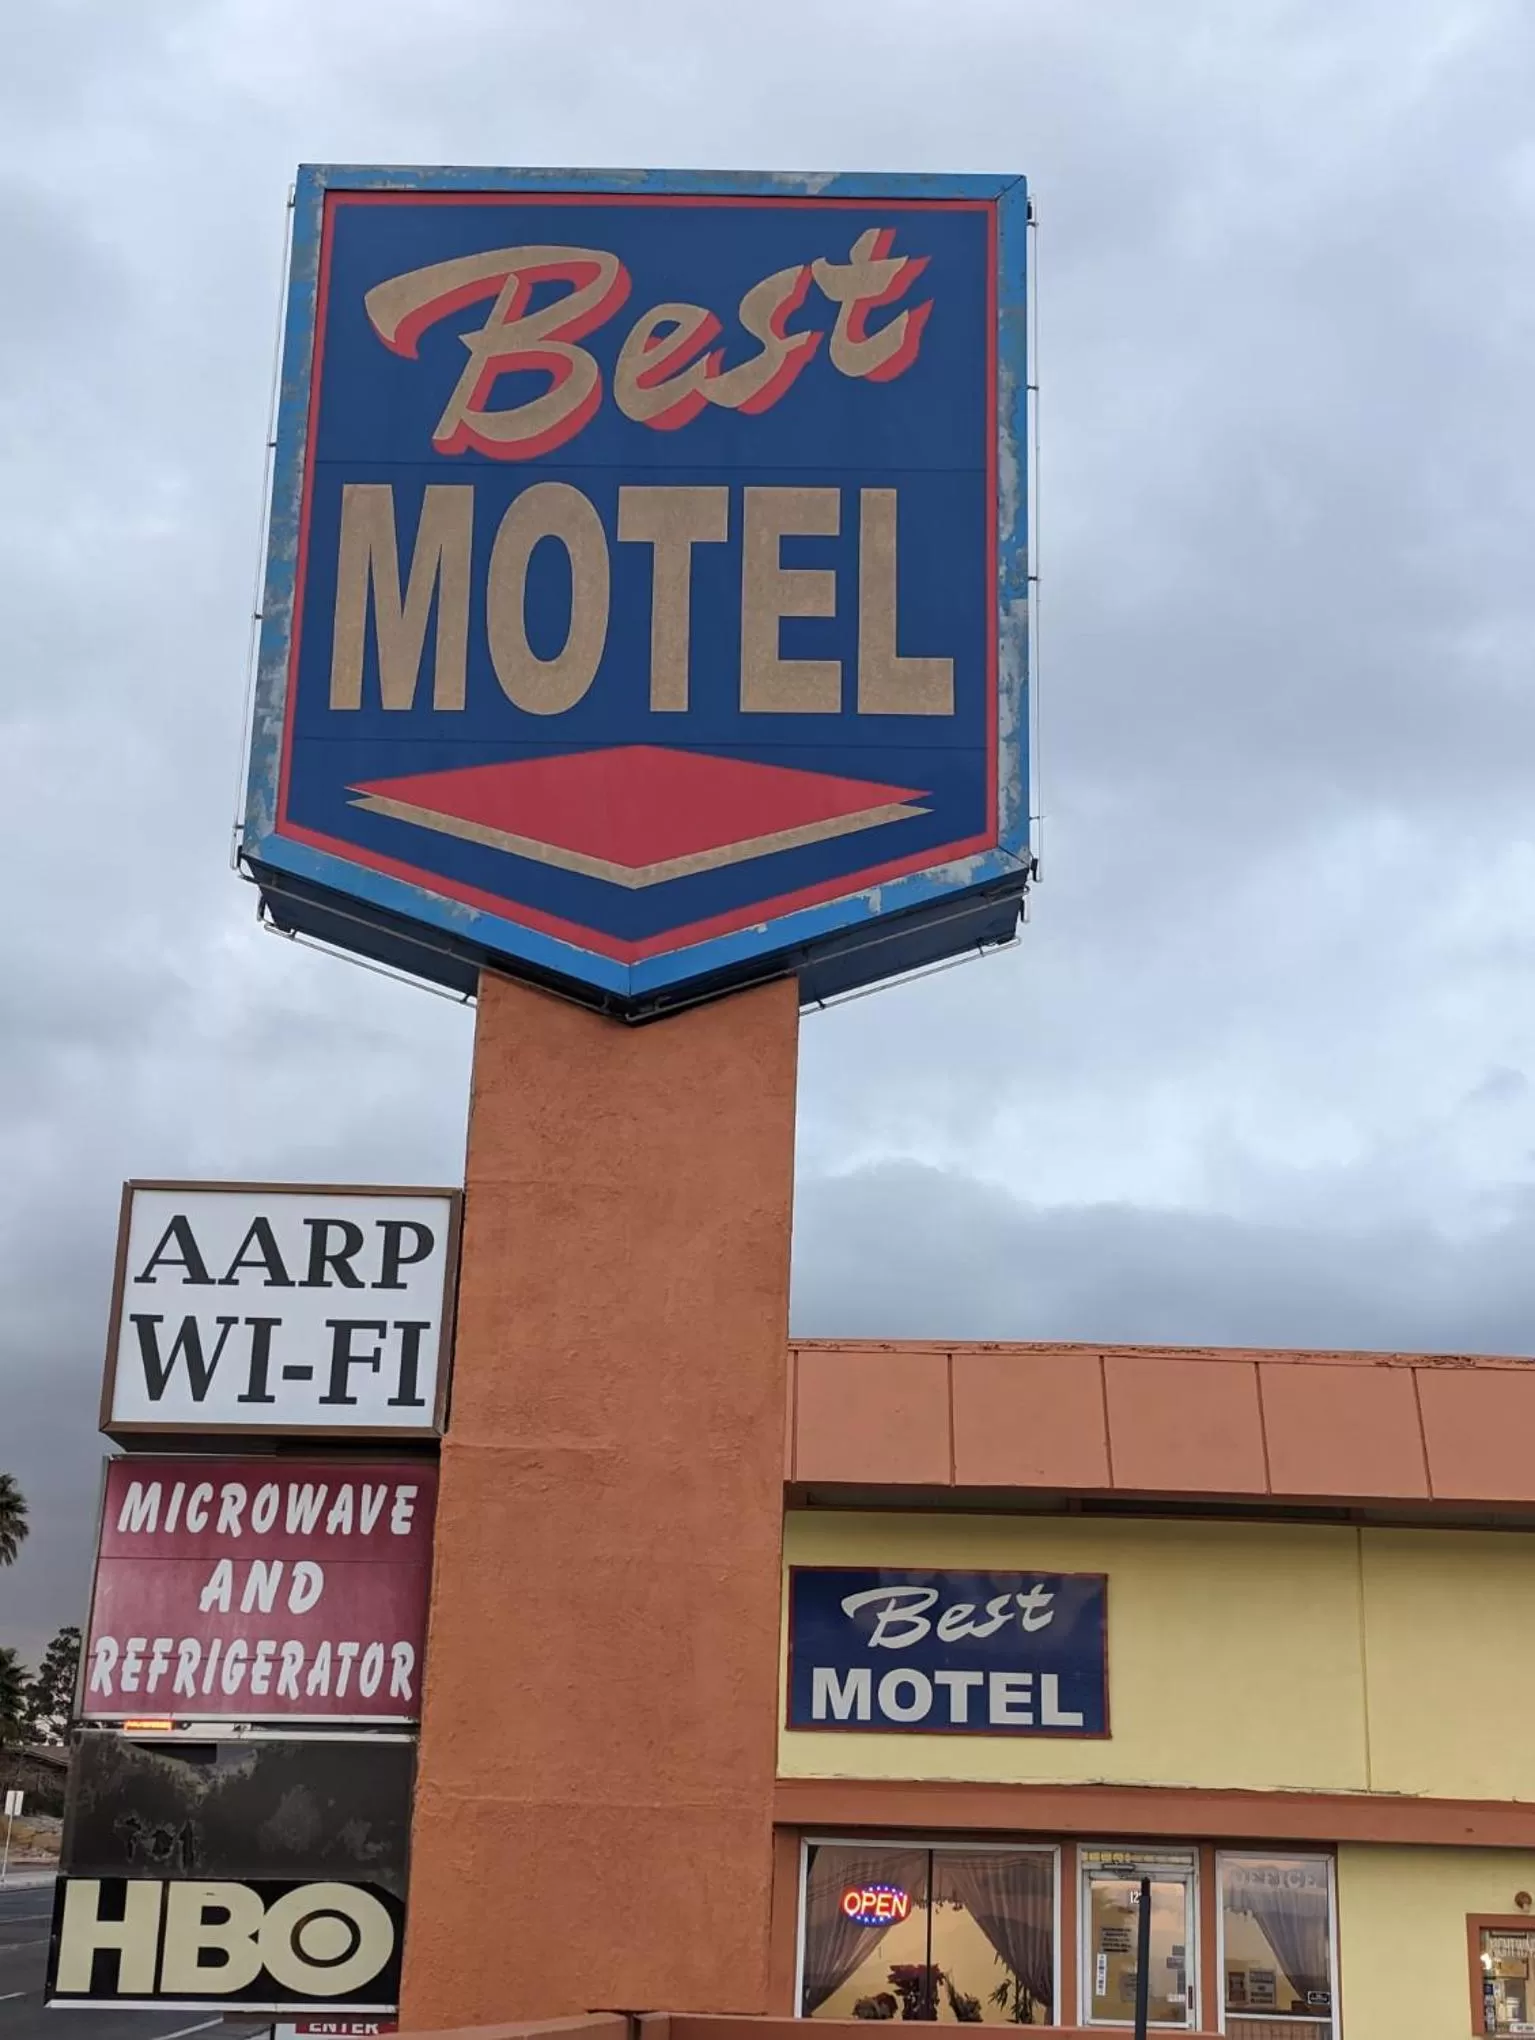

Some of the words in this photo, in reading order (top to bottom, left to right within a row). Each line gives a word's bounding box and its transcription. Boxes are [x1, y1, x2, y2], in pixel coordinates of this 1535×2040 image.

[364, 227, 934, 460] Best
[329, 481, 955, 716] MOTEL
[134, 1215, 435, 1290] AARP
[129, 1313, 431, 1407] WI-FI
[117, 1481, 418, 1537] MICROWAVE
[199, 1559, 324, 1614] AND
[841, 1583, 1055, 1649] Best
[90, 1636, 415, 1701] REFRIGERATOR
[812, 1667, 1084, 1727] MOTEL
[843, 1891, 907, 1917] OPEN
[55, 1879, 394, 1996] HBO
